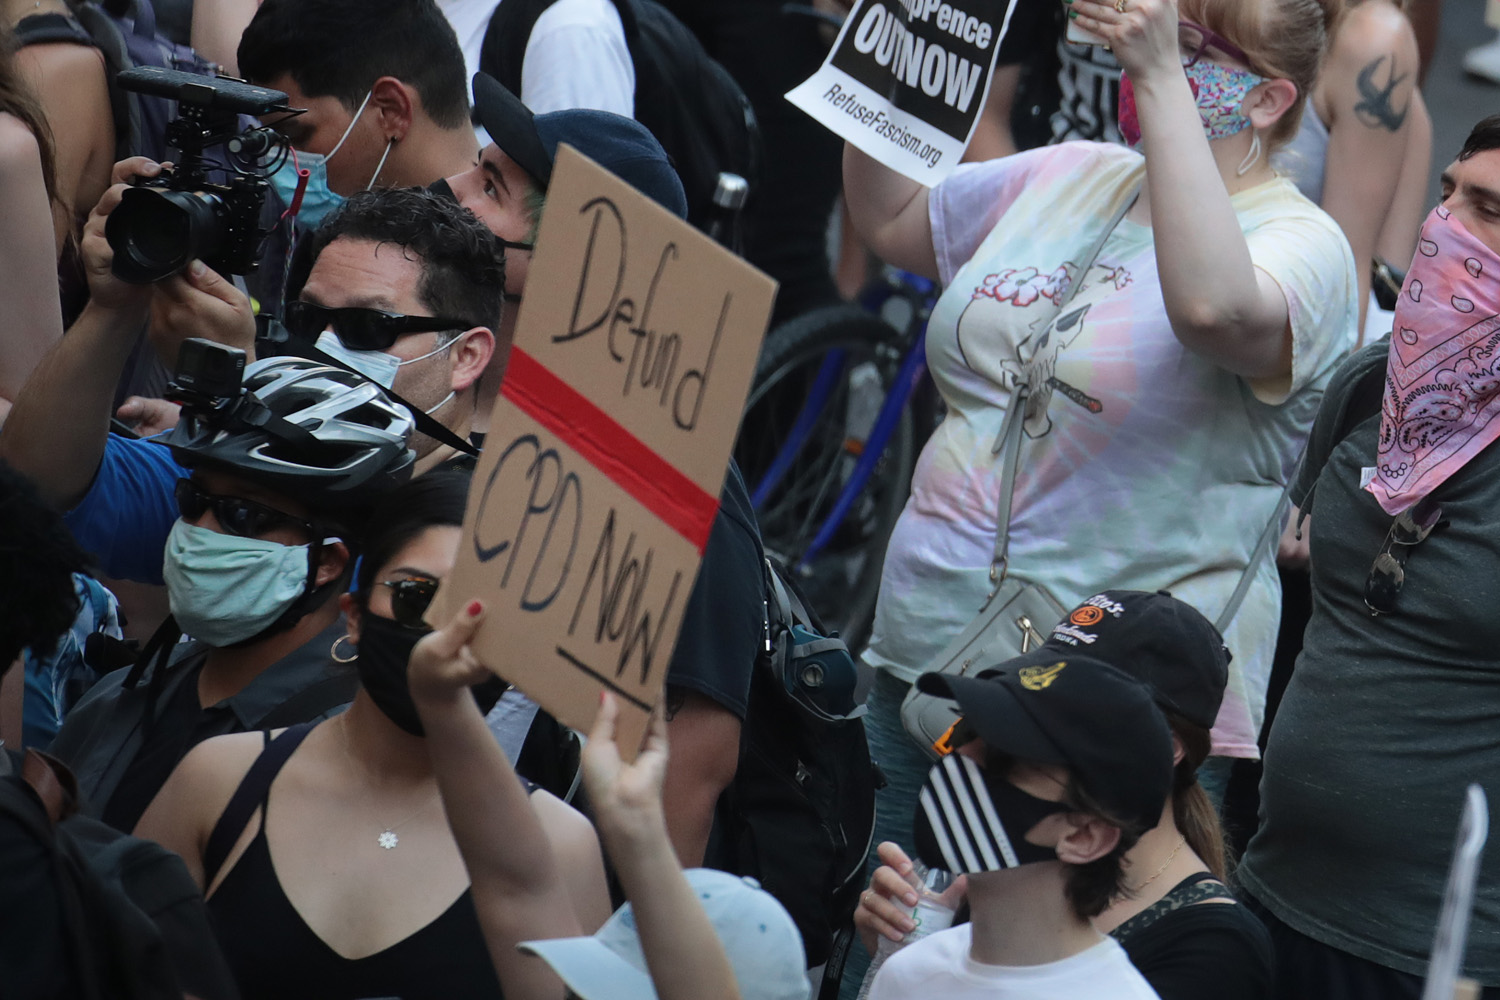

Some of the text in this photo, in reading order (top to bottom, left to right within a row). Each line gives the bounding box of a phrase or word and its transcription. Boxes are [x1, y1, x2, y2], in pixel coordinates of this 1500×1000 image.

[822, 82, 943, 169] RefuseFascism.org
[551, 196, 733, 432] Defund
[473, 434, 584, 613] CPD
